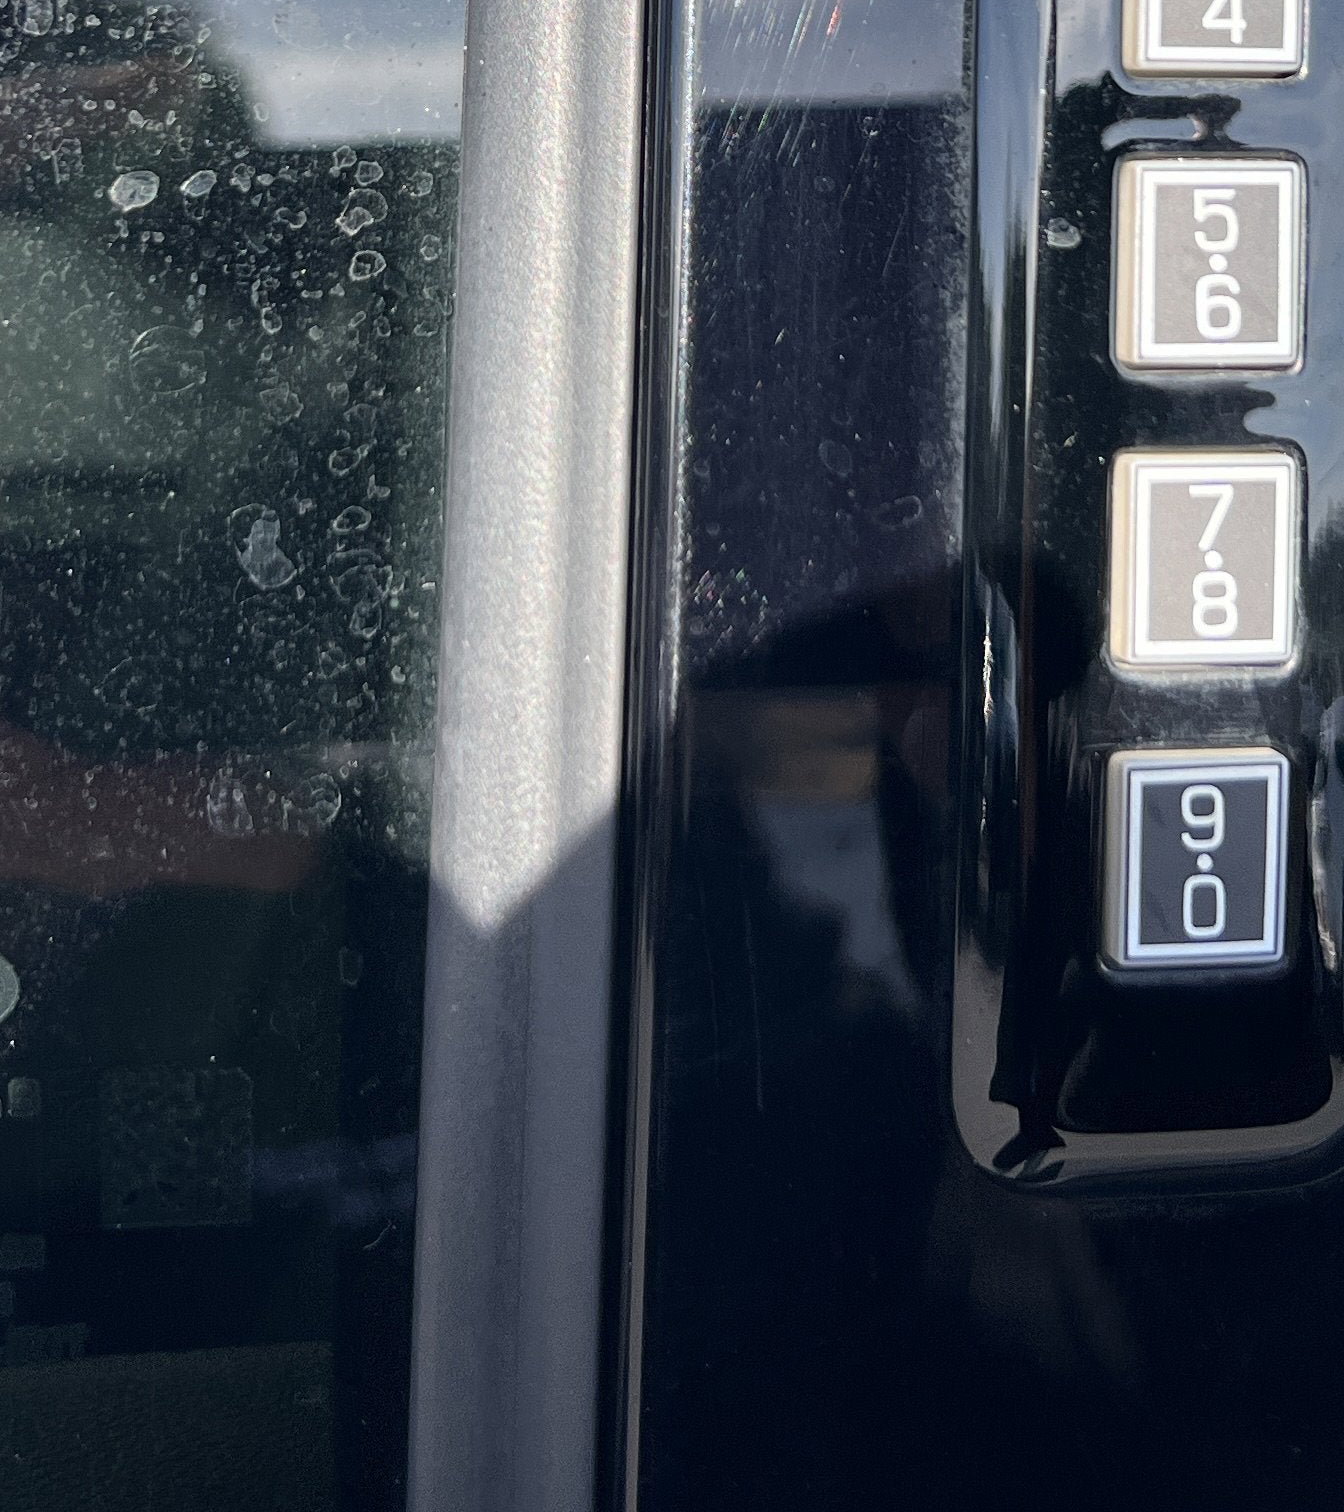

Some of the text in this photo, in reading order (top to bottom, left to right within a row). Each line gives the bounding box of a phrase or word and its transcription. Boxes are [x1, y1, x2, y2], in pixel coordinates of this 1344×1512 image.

[1193, 188, 1239, 253] 5
[1195, 273, 1241, 340] 6
[1188, 484, 1234, 551] 7
[1192, 570, 1238, 638] 8
[1181, 784, 1224, 851] 9
[1183, 874, 1226, 938] 0
